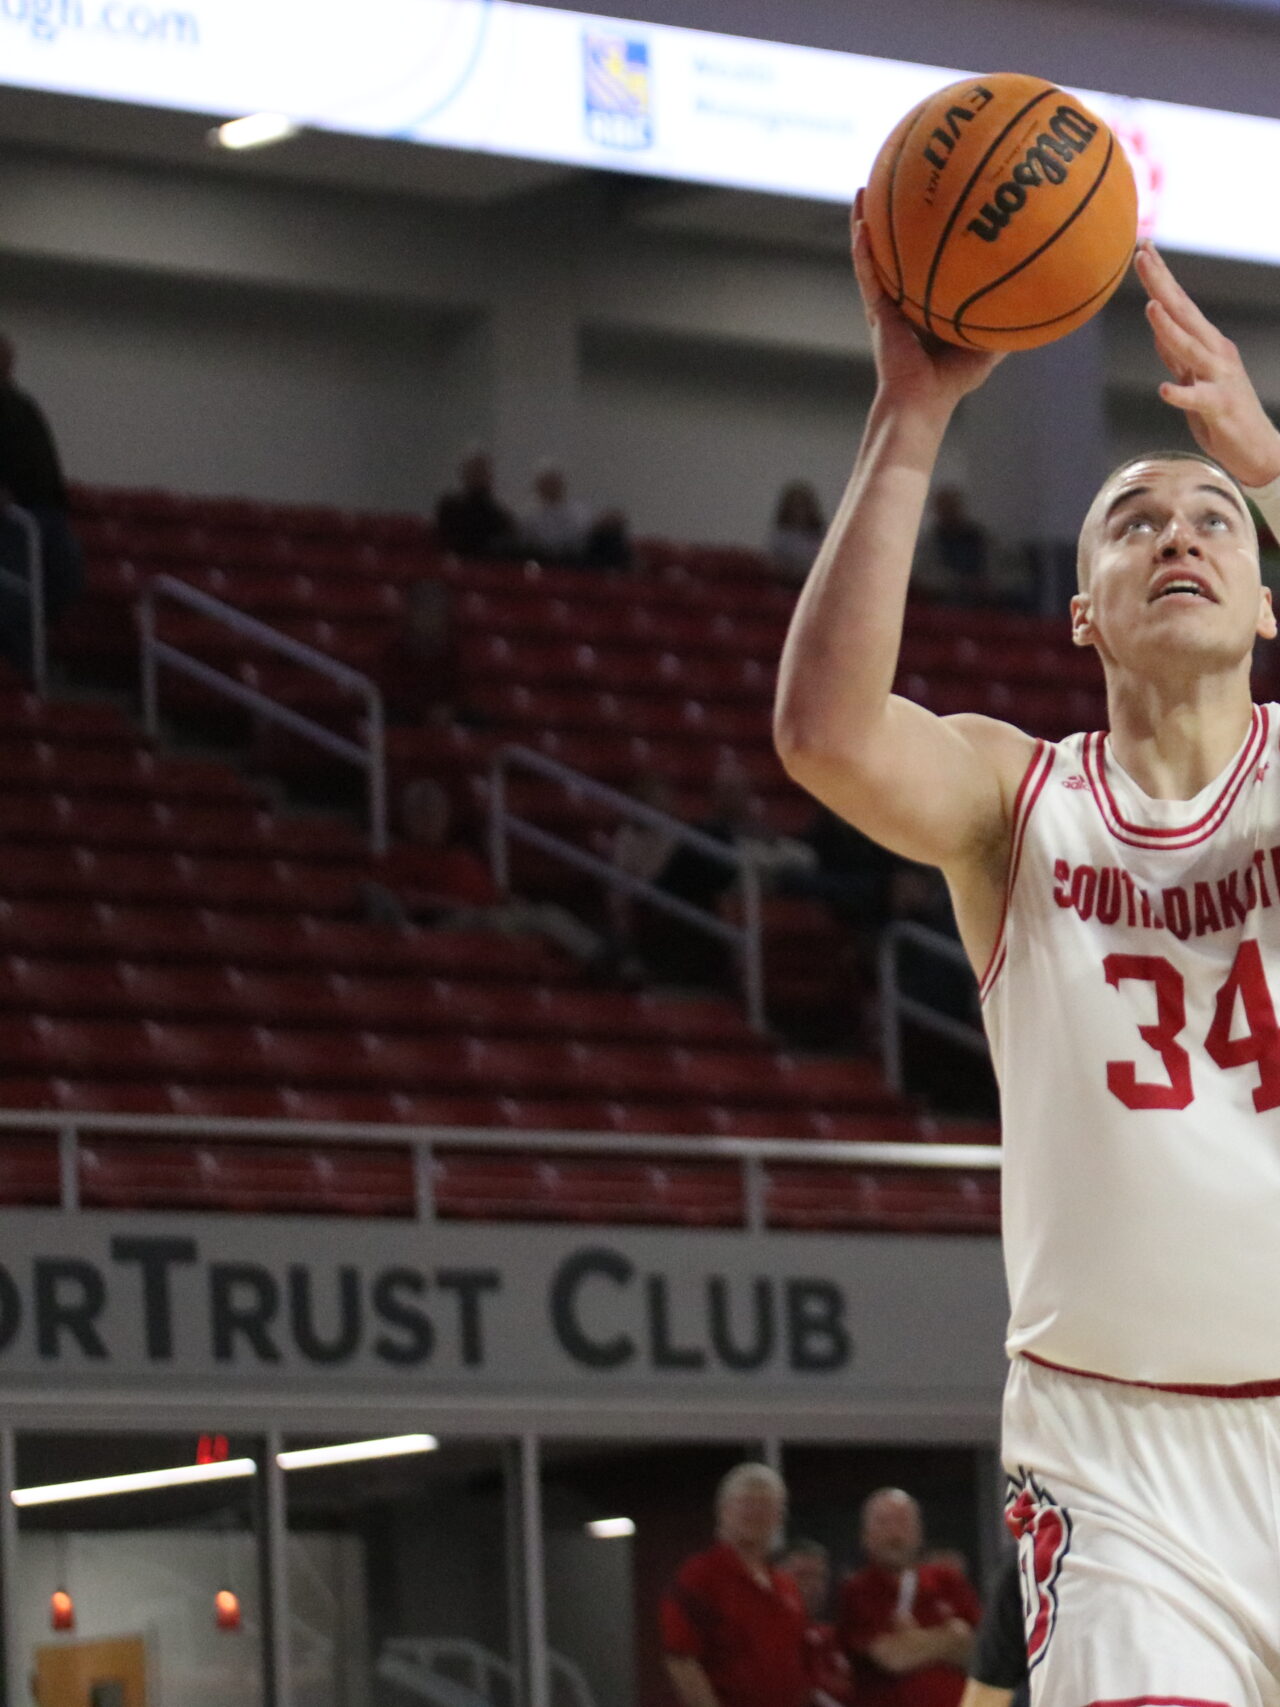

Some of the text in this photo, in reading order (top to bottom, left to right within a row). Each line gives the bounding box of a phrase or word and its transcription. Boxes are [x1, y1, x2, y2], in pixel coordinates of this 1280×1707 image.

[924, 86, 995, 170] EVO
[967, 105, 1098, 242] Wilson
[0, 1234, 502, 1367] RTRUST
